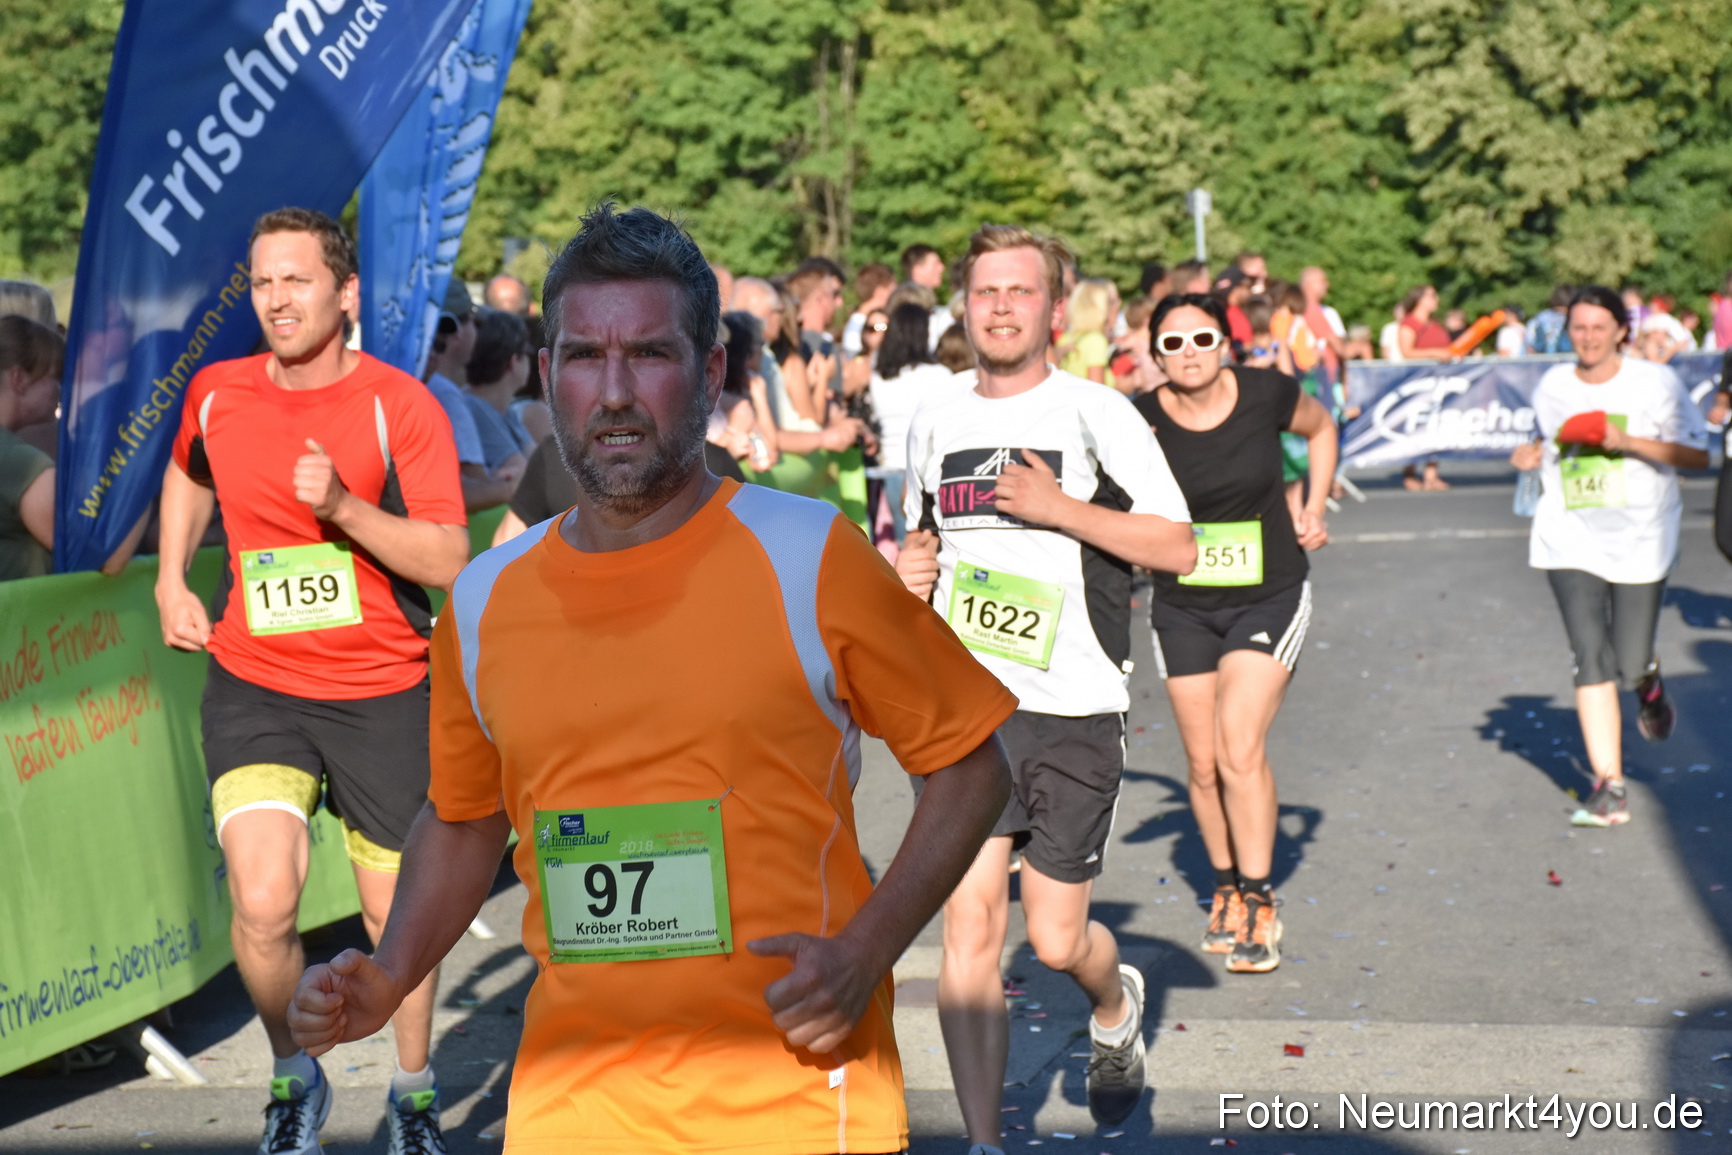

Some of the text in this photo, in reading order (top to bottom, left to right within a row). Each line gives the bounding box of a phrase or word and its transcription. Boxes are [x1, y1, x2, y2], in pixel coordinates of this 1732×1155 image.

[318, 0, 388, 81] Druck
[1196, 545, 1247, 568] 551
[256, 574, 339, 609] 1159
[963, 595, 1040, 641] 1622
[5, 703, 85, 785] laufen
[551, 830, 610, 848] firmenlauf
[619, 840, 654, 854] 2018
[584, 861, 655, 918] 97
[575, 917, 679, 936] Kröber Robert
[596, 936, 622, 944] Dr.-Ing.
[622, 934, 648, 943] Spotka
[665, 930, 693, 939] Partner
[694, 928, 718, 937] GmbH
